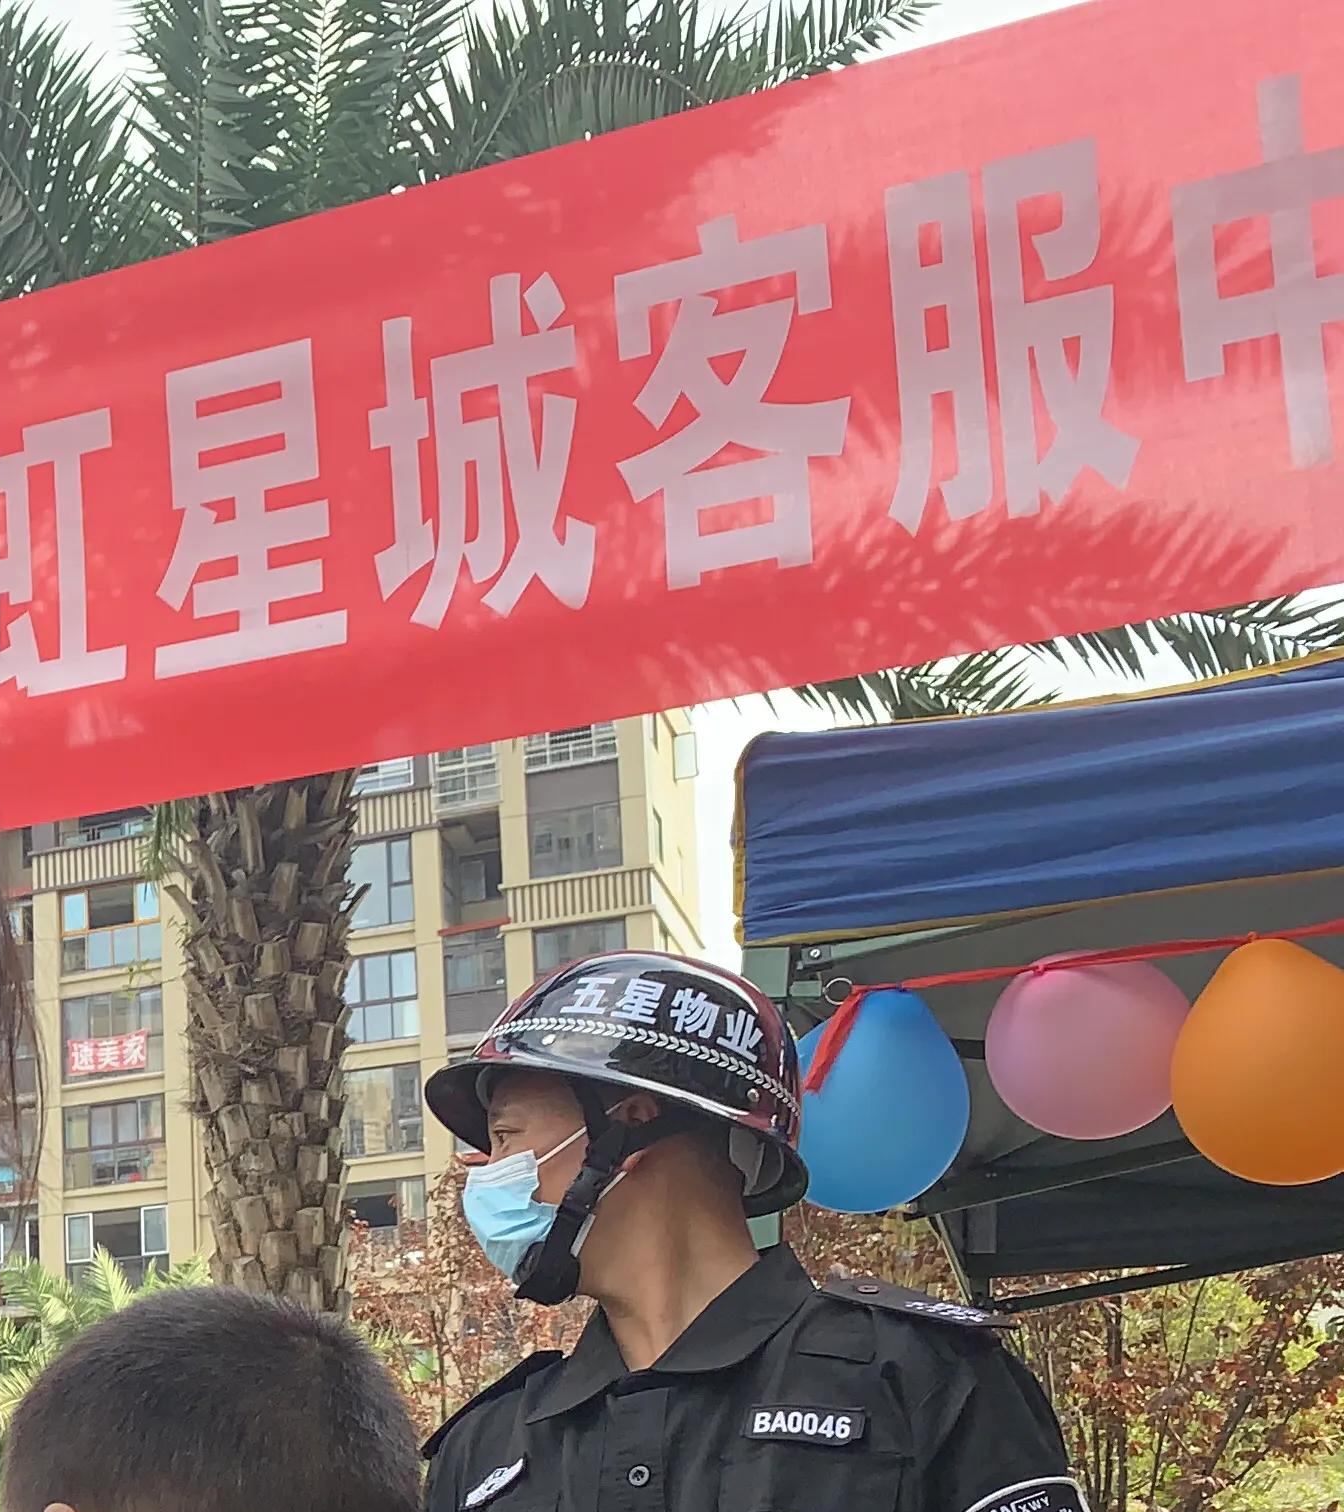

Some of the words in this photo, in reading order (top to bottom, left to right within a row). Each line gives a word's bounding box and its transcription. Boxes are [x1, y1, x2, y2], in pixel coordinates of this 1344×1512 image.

[560, 977, 764, 1064] 五星物业
[752, 1410, 852, 1439] BA0046
